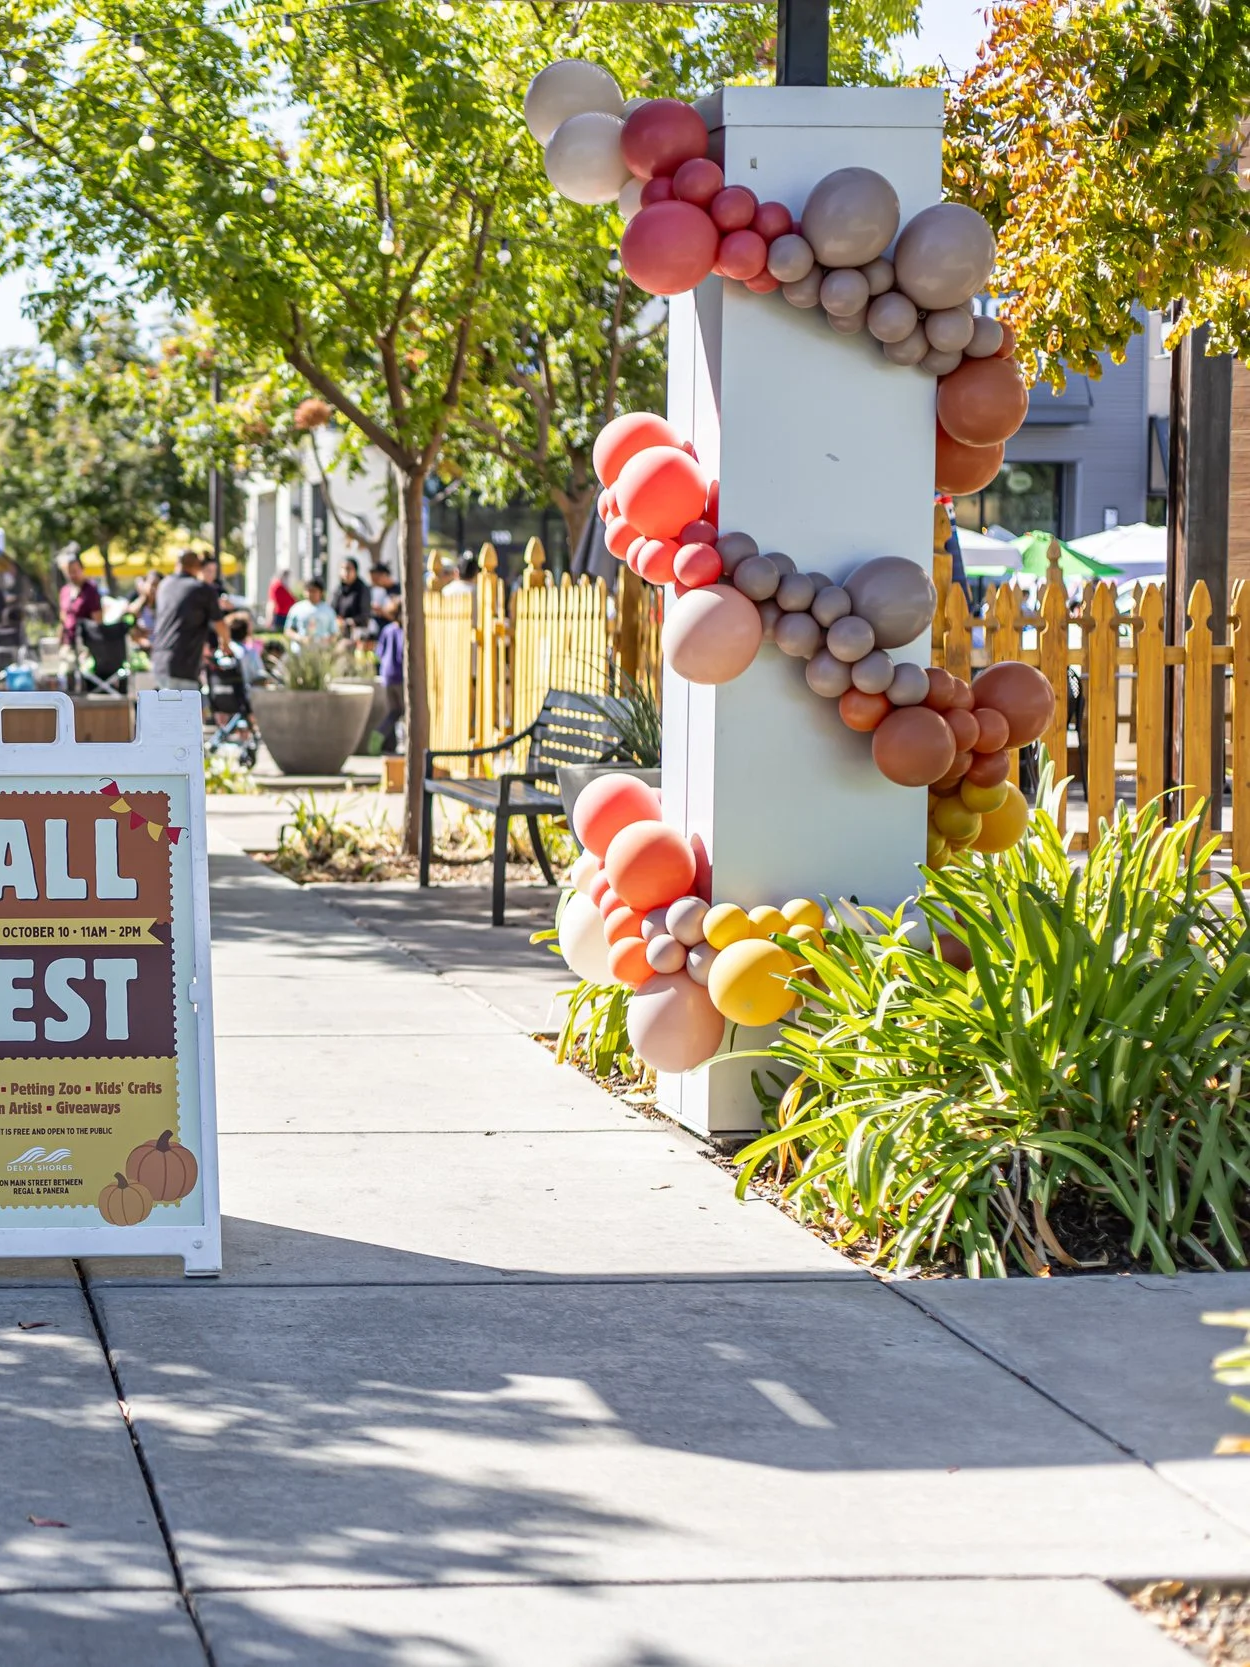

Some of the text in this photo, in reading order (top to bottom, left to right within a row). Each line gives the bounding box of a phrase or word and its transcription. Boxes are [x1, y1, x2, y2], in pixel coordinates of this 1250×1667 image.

[2, 926, 54, 938] OCTOBER
[58, 926, 70, 938] 10
[81, 926, 107, 938] 11AM
[119, 926, 141, 938] 2PM
[10, 1082, 55, 1097] Petting
[58, 1082, 82, 1095] Zoo
[95, 1081, 125, 1095] Kids'
[127, 1081, 163, 1095] Crafts
[9, 1101, 43, 1115] Artist
[55, 1101, 121, 1115] Giveaways
[47, 1127, 65, 1135] OPEN
[67, 1127, 75, 1135] TO
[76, 1127, 88, 1135] THE
[90, 1127, 113, 1135] PUBLIC
[0, 1178, 83, 1187] ON MAIN STREET BETWEEN
[13, 1187, 35, 1195] REGAL
[36, 1187, 42, 1195] &
